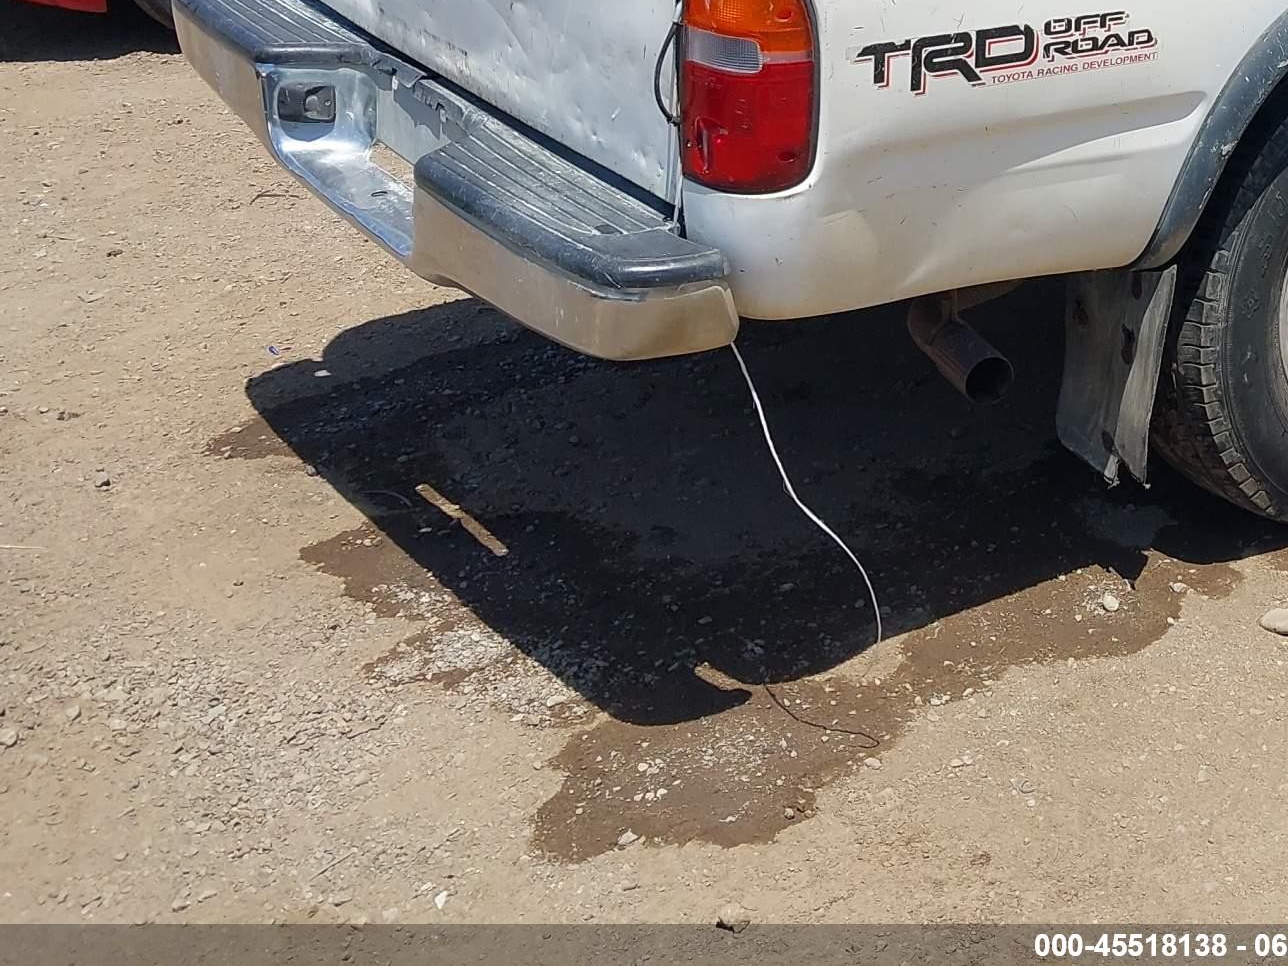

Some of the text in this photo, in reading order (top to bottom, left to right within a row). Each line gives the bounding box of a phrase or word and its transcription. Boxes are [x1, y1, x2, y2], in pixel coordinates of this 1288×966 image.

[1043, 10, 1129, 39] OFF
[852, 23, 1039, 96] TRD
[1042, 28, 1158, 63] ROAD
[991, 51, 1158, 85] TOYOTA RACING DEVELOPMENT
